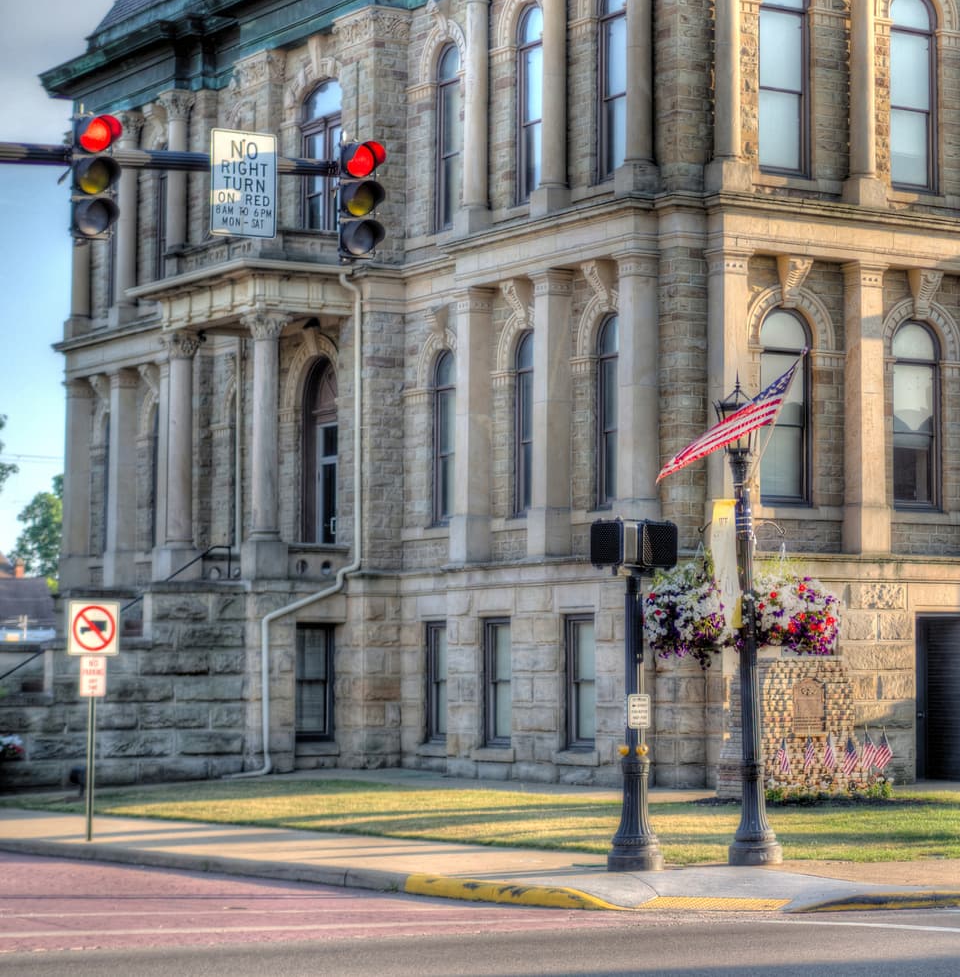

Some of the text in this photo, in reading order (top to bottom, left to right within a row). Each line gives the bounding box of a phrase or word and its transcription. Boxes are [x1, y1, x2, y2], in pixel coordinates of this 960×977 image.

[231, 140, 258, 160] NO
[221, 159, 268, 178] RIGHT
[223, 176, 265, 193] TURN
[218, 191, 270, 207] ON RED
[239, 206, 249, 216] TO
[222, 217, 241, 227] MON
[251, 219, 265, 229] SAT
